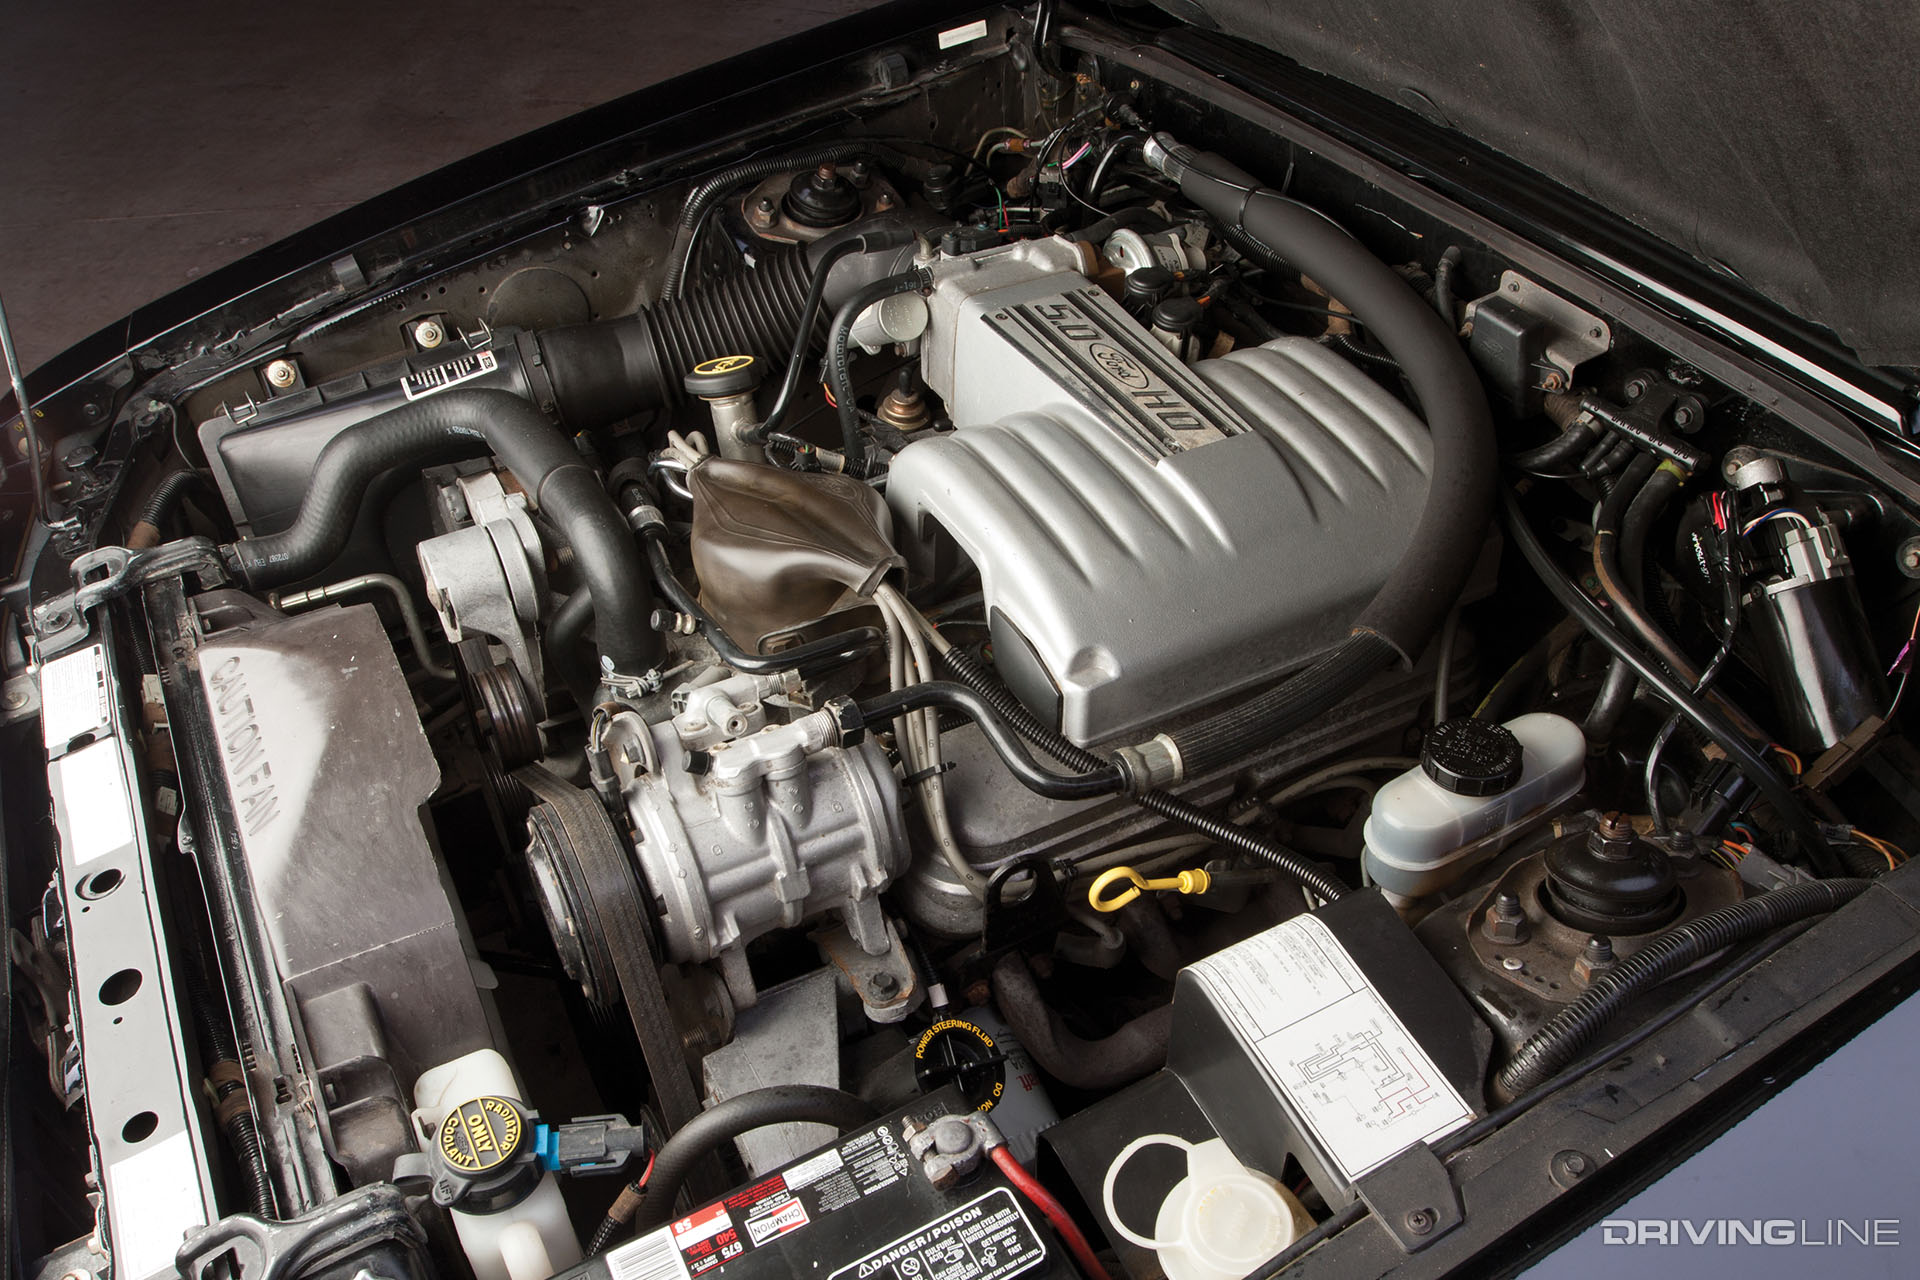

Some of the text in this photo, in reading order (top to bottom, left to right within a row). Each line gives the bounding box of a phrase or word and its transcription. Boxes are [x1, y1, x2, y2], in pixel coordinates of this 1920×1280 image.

[1034, 304, 1206, 430] 5.0 Ford HO
[210, 656, 281, 836] CAUTION FAN
[915, 1019, 994, 1059] POWER STEERING FLUID
[992, 1082, 1003, 1097] DO
[467, 1114, 494, 1153] ONLY
[485, 1100, 517, 1151] RADIATOR
[443, 1117, 475, 1167] COOLANT
[439, 1178, 454, 1202] LIFT
[673, 1217, 693, 1234] 58
[752, 1206, 801, 1237] CHAMPION
[961, 1207, 1011, 1238] FLUSH EYES WITH
[965, 1210, 1020, 1245] WATER IMMEDIATELY
[714, 1227, 737, 1246] 540
[871, 1236, 927, 1271] DANGER
[931, 1206, 983, 1239] POISON
[924, 1236, 956, 1257] SULFURIC
[980, 1225, 1017, 1248] GET MEDICAL
[1002, 1234, 1017, 1248] HELP
[719, 1240, 743, 1259] 675
[928, 1251, 945, 1265] ACID
[1007, 1243, 1023, 1257] FAST
[934, 1260, 963, 1279] CAN CAUSE
[965, 1262, 975, 1273] OR
[992, 1266, 1006, 1277] CAPS
